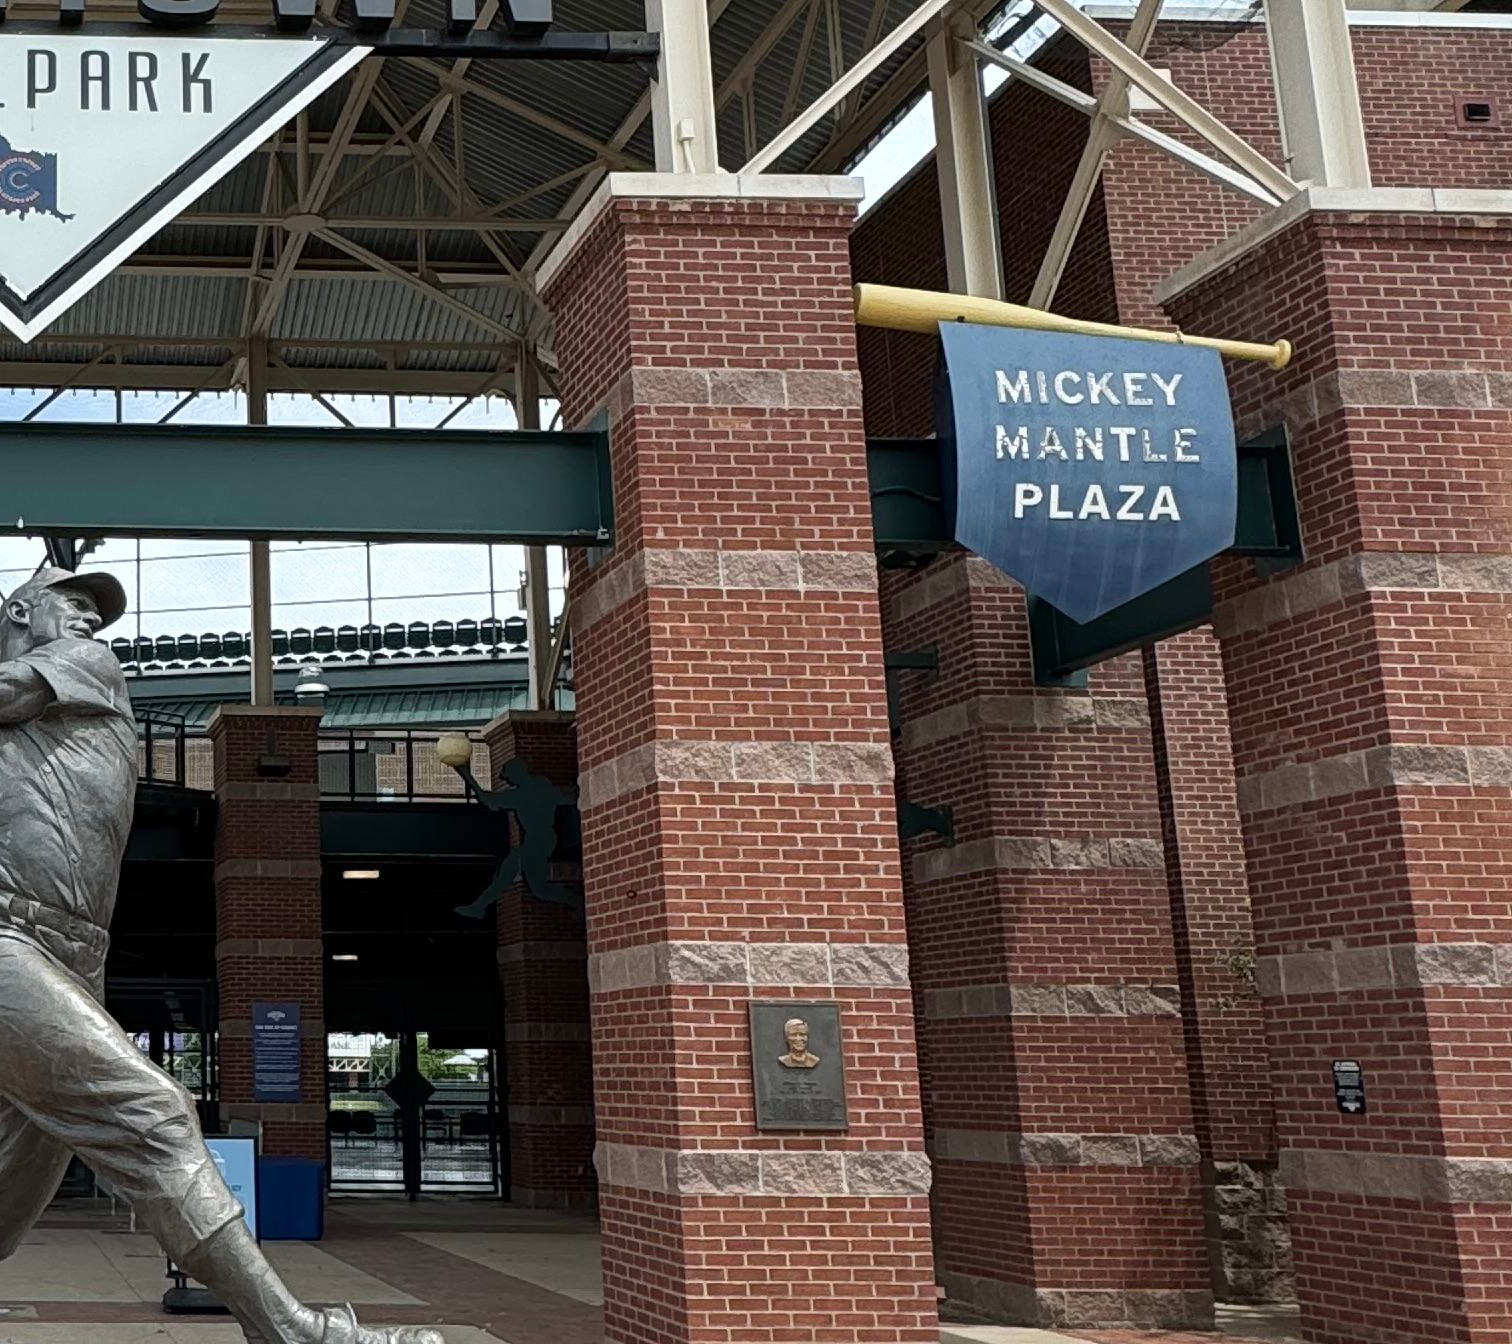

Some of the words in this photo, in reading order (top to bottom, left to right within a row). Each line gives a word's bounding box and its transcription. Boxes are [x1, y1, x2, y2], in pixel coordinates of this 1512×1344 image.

[995, 369, 1184, 407] MICKEY
[995, 424, 1201, 463] MANTLE
[1013, 482, 1182, 522] PLAZA
